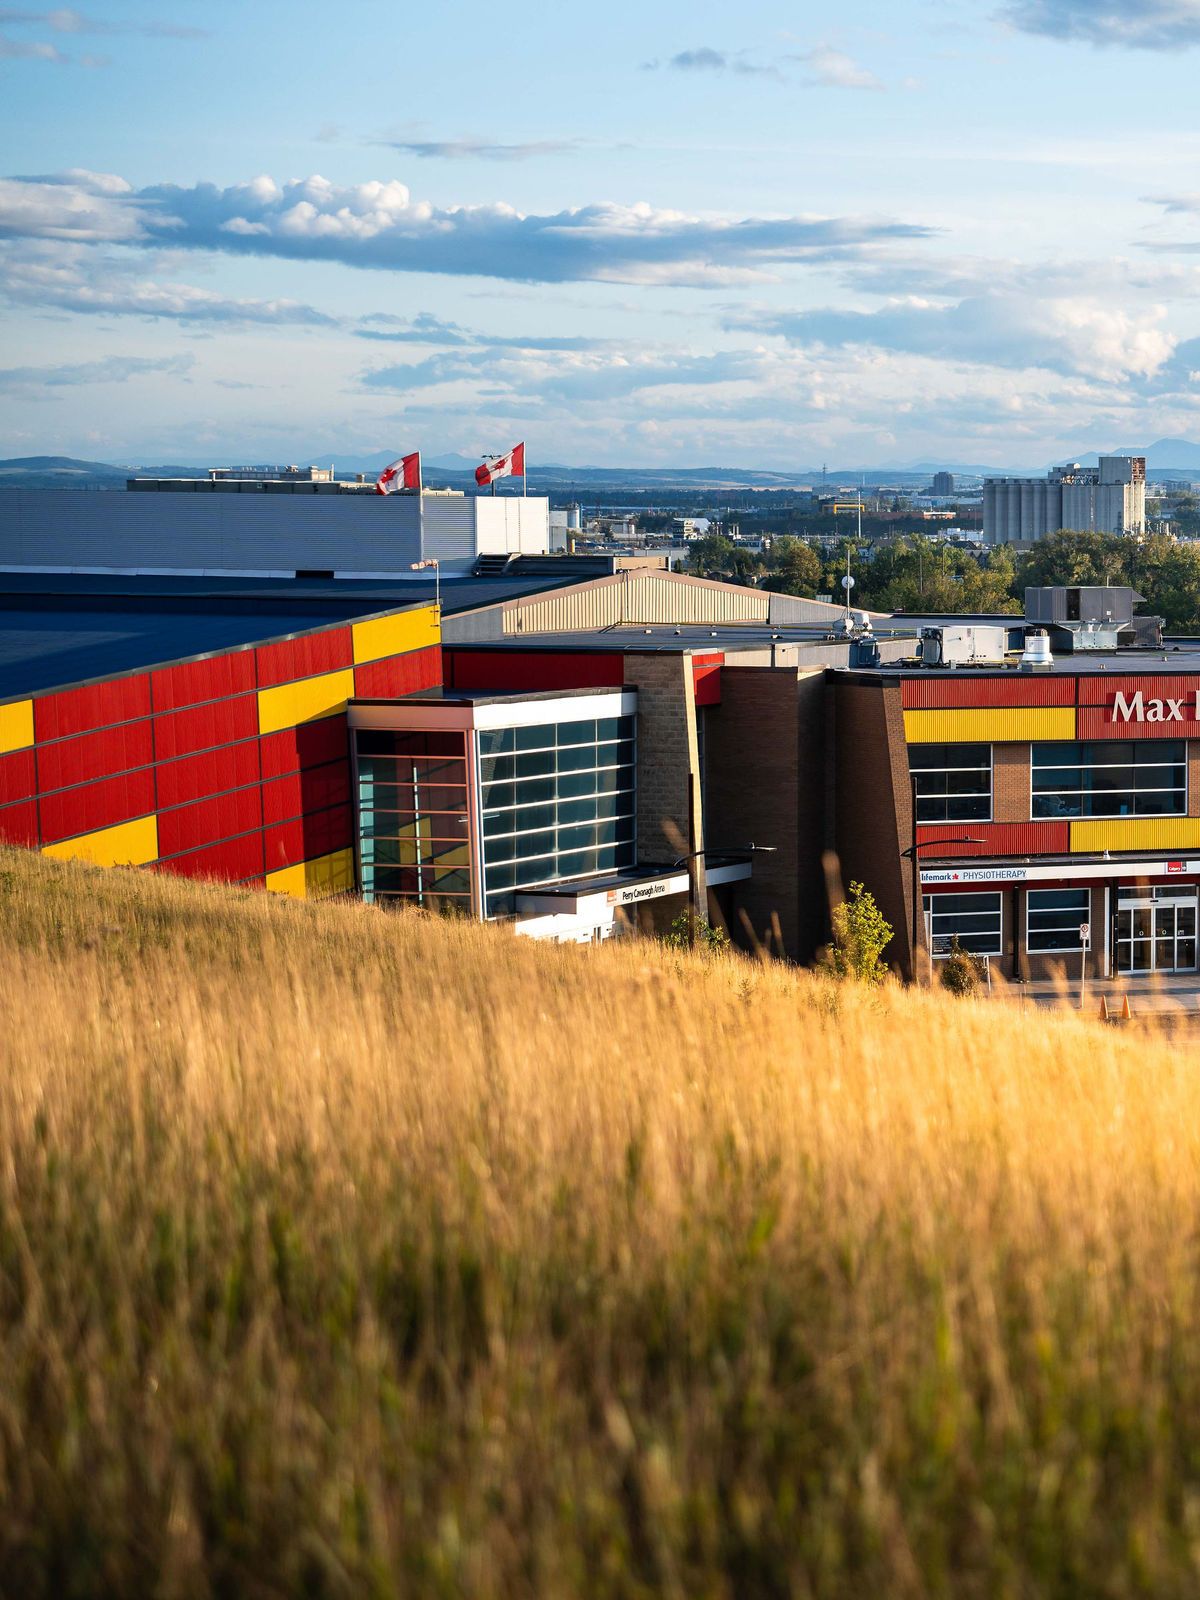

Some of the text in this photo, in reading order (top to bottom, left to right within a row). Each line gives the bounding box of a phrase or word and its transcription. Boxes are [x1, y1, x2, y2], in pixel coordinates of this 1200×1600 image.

[1112, 691, 1184, 722] Max
[963, 870, 1027, 880] PHYSIOTHERAPY
[622, 891, 634, 901] Perry
[634, 886, 653, 897] Cavanagh
[653, 884, 665, 894] Arena
